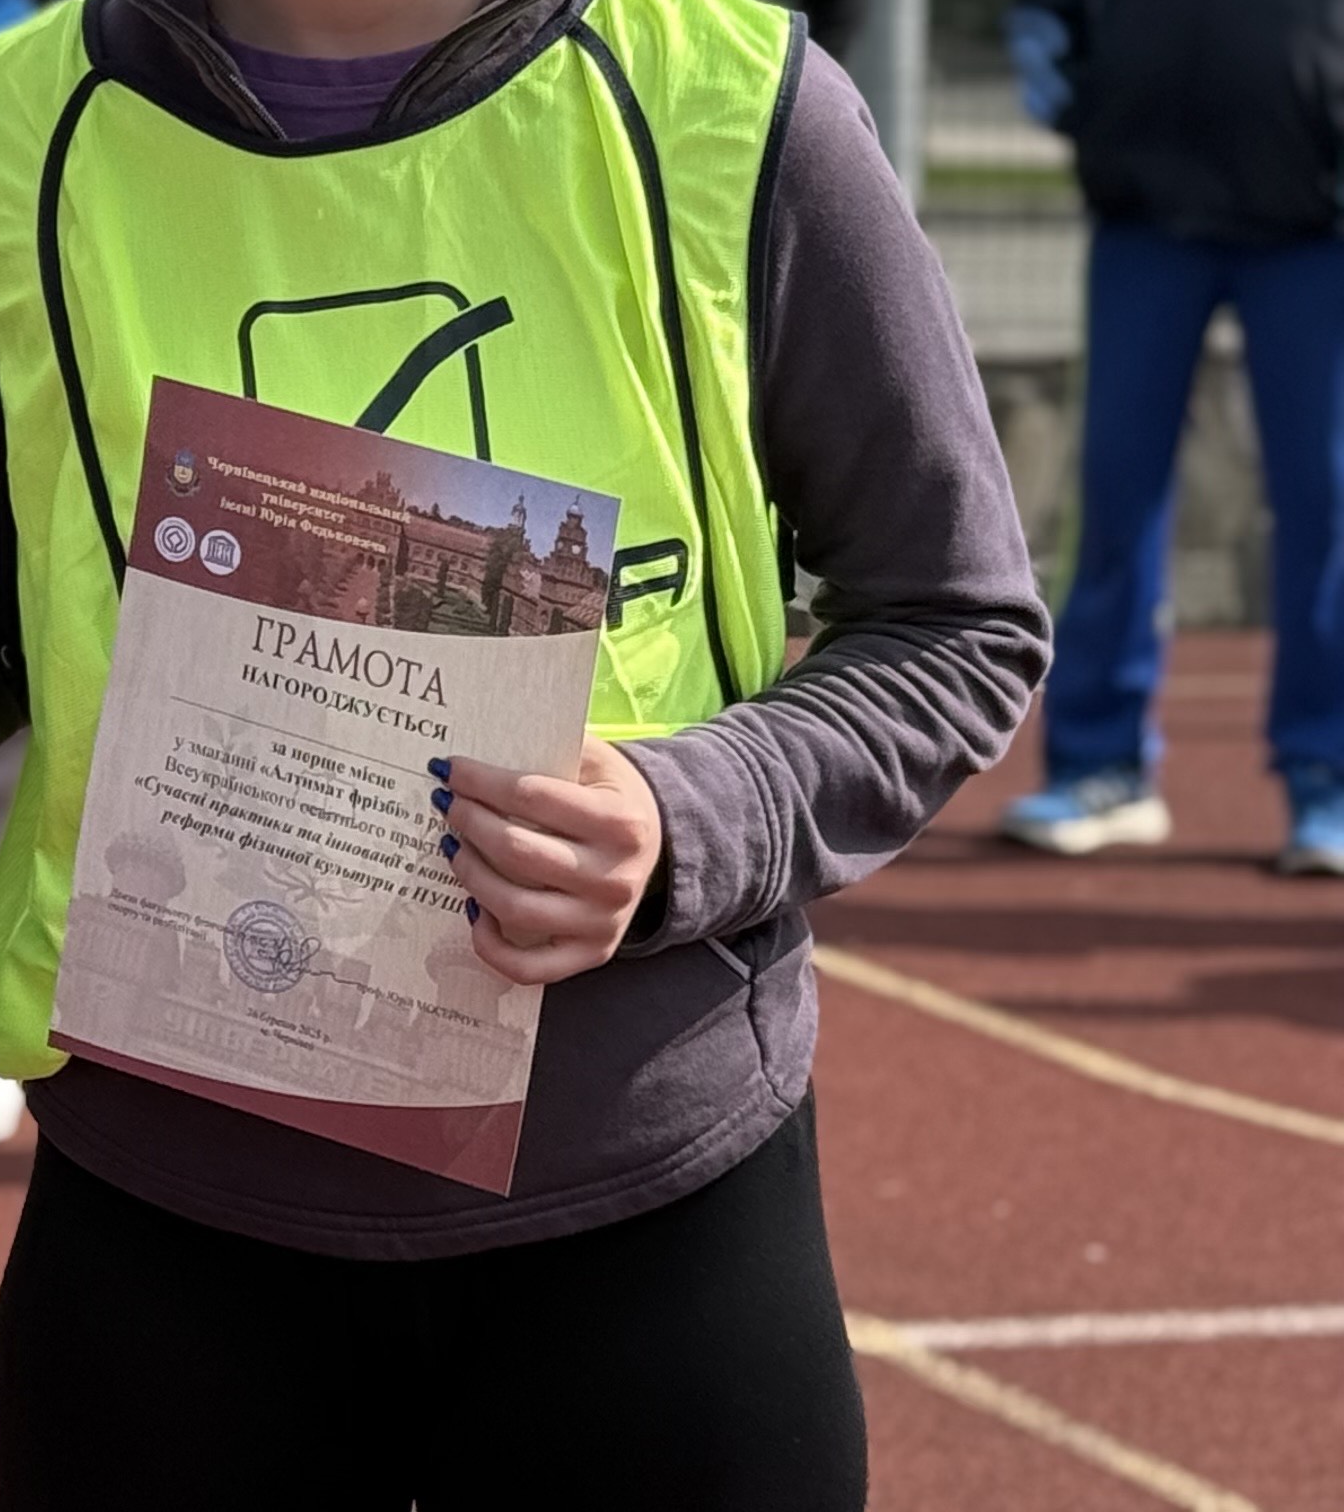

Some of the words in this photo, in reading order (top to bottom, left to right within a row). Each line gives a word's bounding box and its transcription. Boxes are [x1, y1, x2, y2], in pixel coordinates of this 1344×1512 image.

[259, 507, 297, 529] Юрія
[251, 614, 448, 708] ГРАМОТА
[241, 663, 449, 742] НАГОРОДЖУЄТЬСЯ
[165, 755, 296, 810] Всеукраїнського
[172, 736, 185, 752] у
[414, 813, 424, 825] в
[270, 740, 287, 756] за
[291, 747, 347, 774] перше
[350, 765, 397, 790] місце
[134, 775, 207, 808] «Сучасні
[209, 799, 295, 835] практики
[296, 825, 322, 844] та
[160, 809, 235, 843] реформи
[238, 832, 314, 866] фізичної
[314, 857, 395, 892] культури
[411, 886, 467, 915] НУШ
